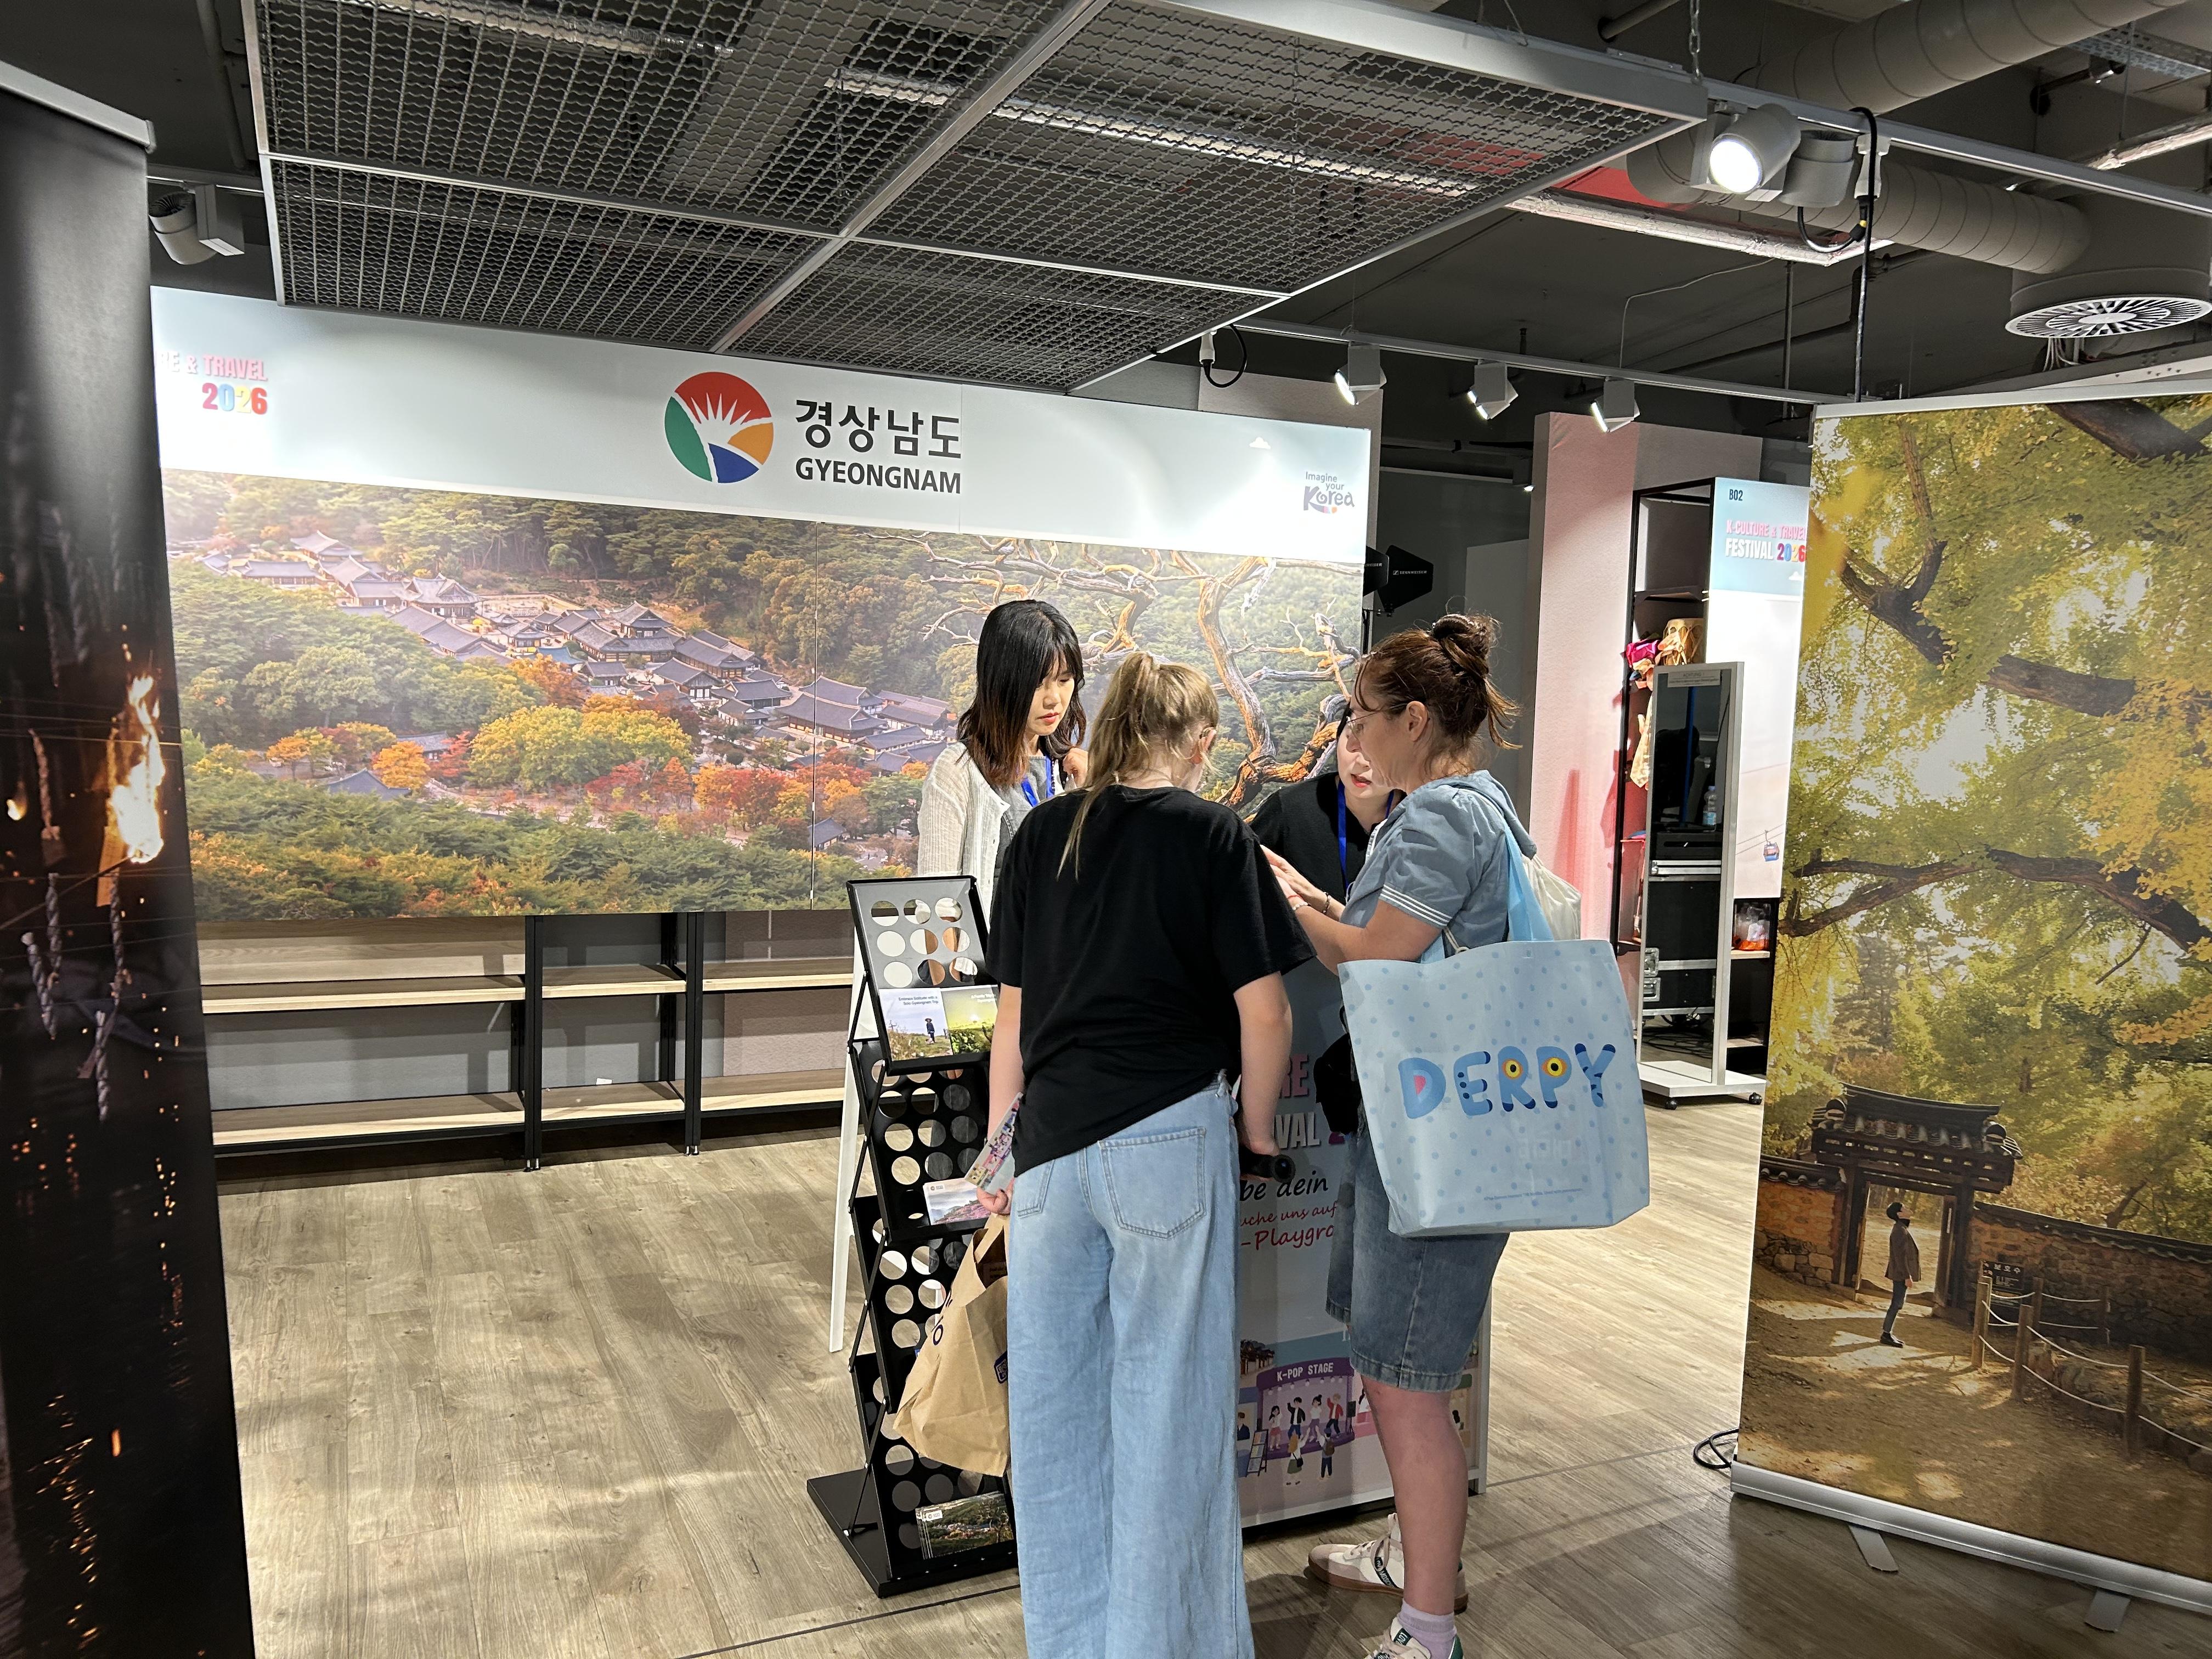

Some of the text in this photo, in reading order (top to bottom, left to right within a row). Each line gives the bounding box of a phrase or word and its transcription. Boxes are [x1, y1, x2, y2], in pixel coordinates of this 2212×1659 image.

[185, 356, 198, 374] &
[202, 354, 268, 381] TRAVEL
[202, 382, 268, 415] 2026
[796, 399, 962, 459] 경상남도
[796, 458, 961, 494] GYEONGNAM
[1306, 471, 1338, 483] Imagine
[1325, 483, 1345, 491] your
[1303, 486, 1355, 514] Korea
[1729, 489, 1743, 501] B02
[1726, 520, 1769, 537] K-CULTURE
[1771, 528, 1777, 538] &
[1725, 538, 1807, 562] FESTIVAL 2026
[1398, 1043, 1616, 1119] DERPY
[1274, 1111, 1320, 1150] VAL
[1280, 1209, 1310, 1221] uns
[1276, 1362, 1334, 1382] K-POP STAGE
